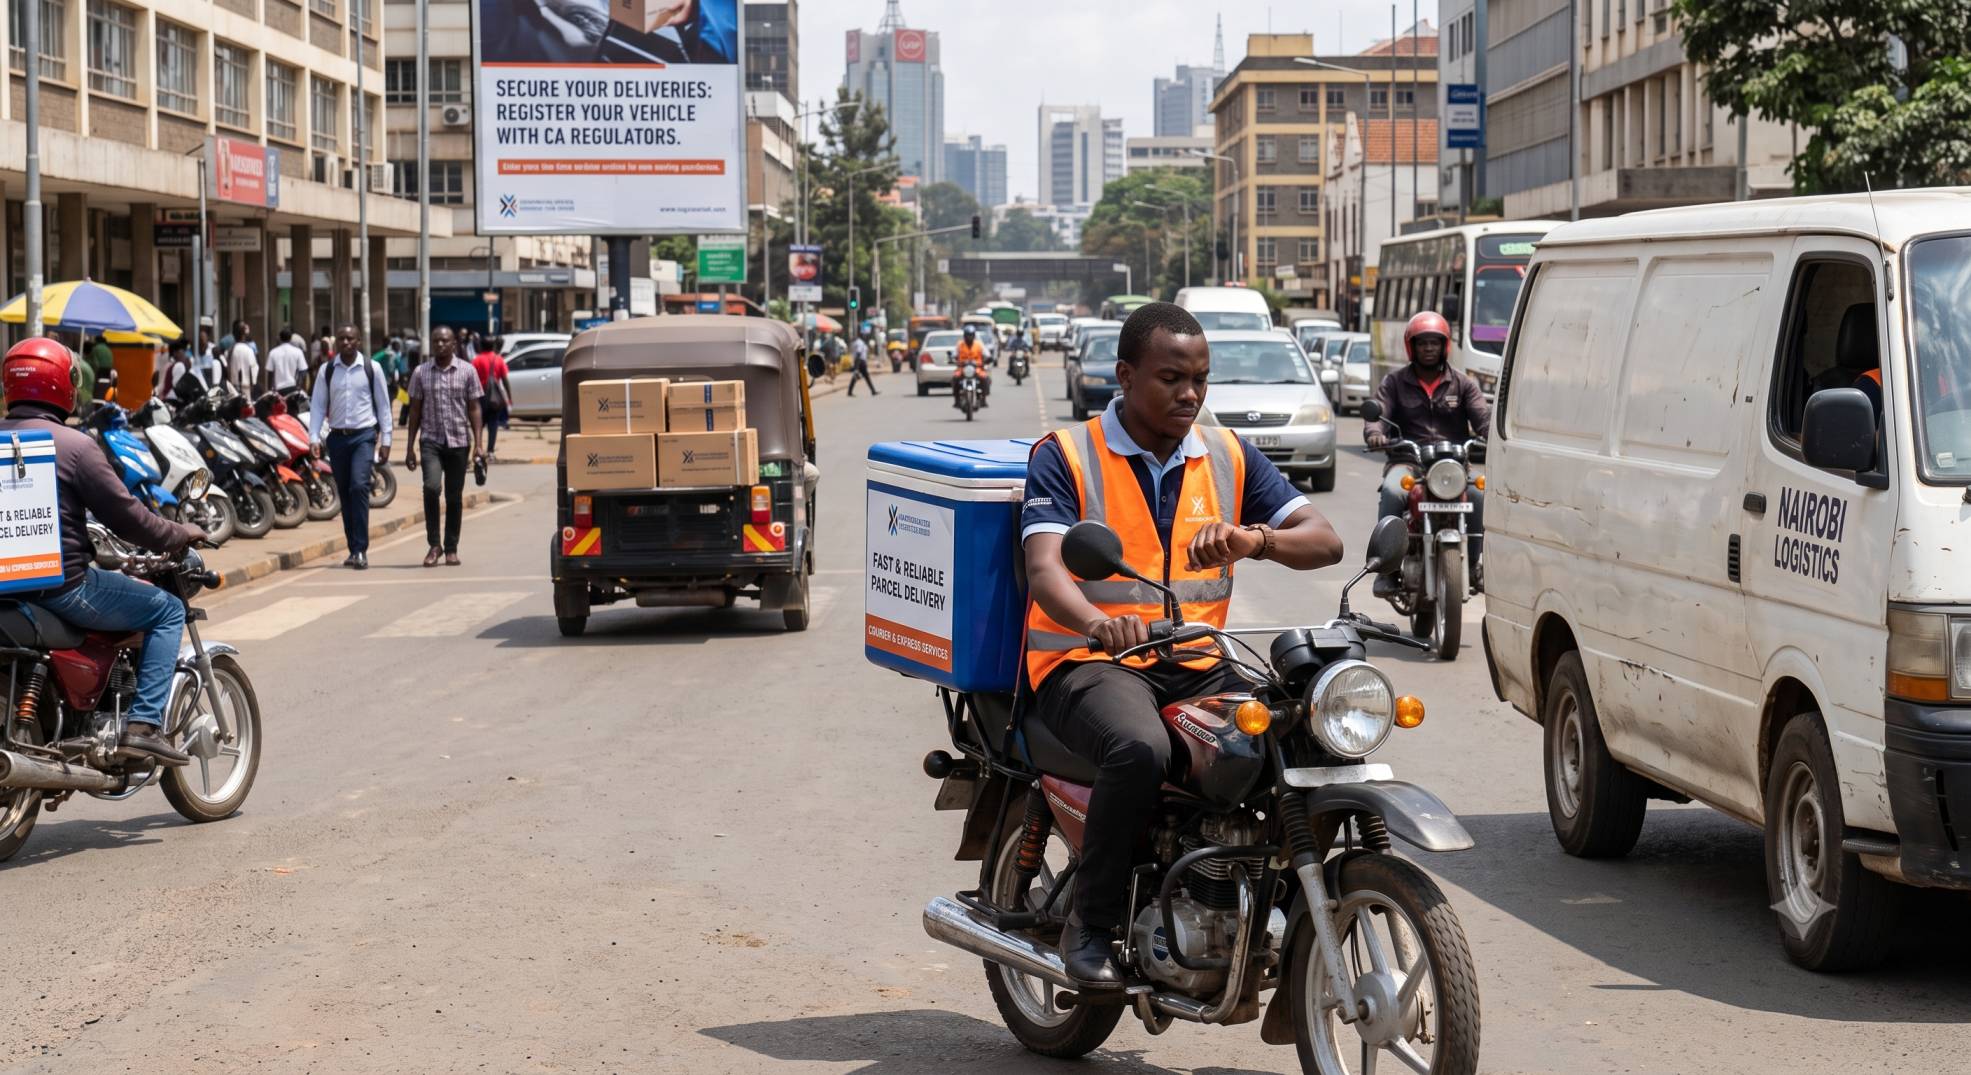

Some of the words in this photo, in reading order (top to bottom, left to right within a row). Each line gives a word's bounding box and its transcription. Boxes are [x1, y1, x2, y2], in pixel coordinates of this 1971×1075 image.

[496, 80, 560, 97] SECURE
[565, 80, 608, 98] YOUR
[614, 81, 712, 98] DELIVERIES:
[496, 104, 576, 121] REGISTER
[581, 104, 624, 121] YOUR
[630, 105, 696, 121] VEHICLE
[497, 127, 539, 144] WITH
[544, 128, 565, 145] CA
[571, 128, 681, 145] REGULATORS.
[6, 511, 12, 521] &
[14, 507, 52, 520] RELIABLE
[1778, 486, 1847, 543] NAIROBI
[0, 527, 14, 539] CEL
[16, 523, 53, 537] DELIVERY
[873, 552, 894, 571] FAST
[895, 561, 901, 575] &
[903, 563, 944, 587] RELIABLE
[1775, 534, 1839, 584] LOGISTICS
[871, 575, 902, 599] PARCEL
[904, 586, 946, 611] DELIVERY
[868, 625, 891, 641] COURIER
[897, 634, 921, 651] EXPRESS
[921, 642, 948, 660] SERVICES
